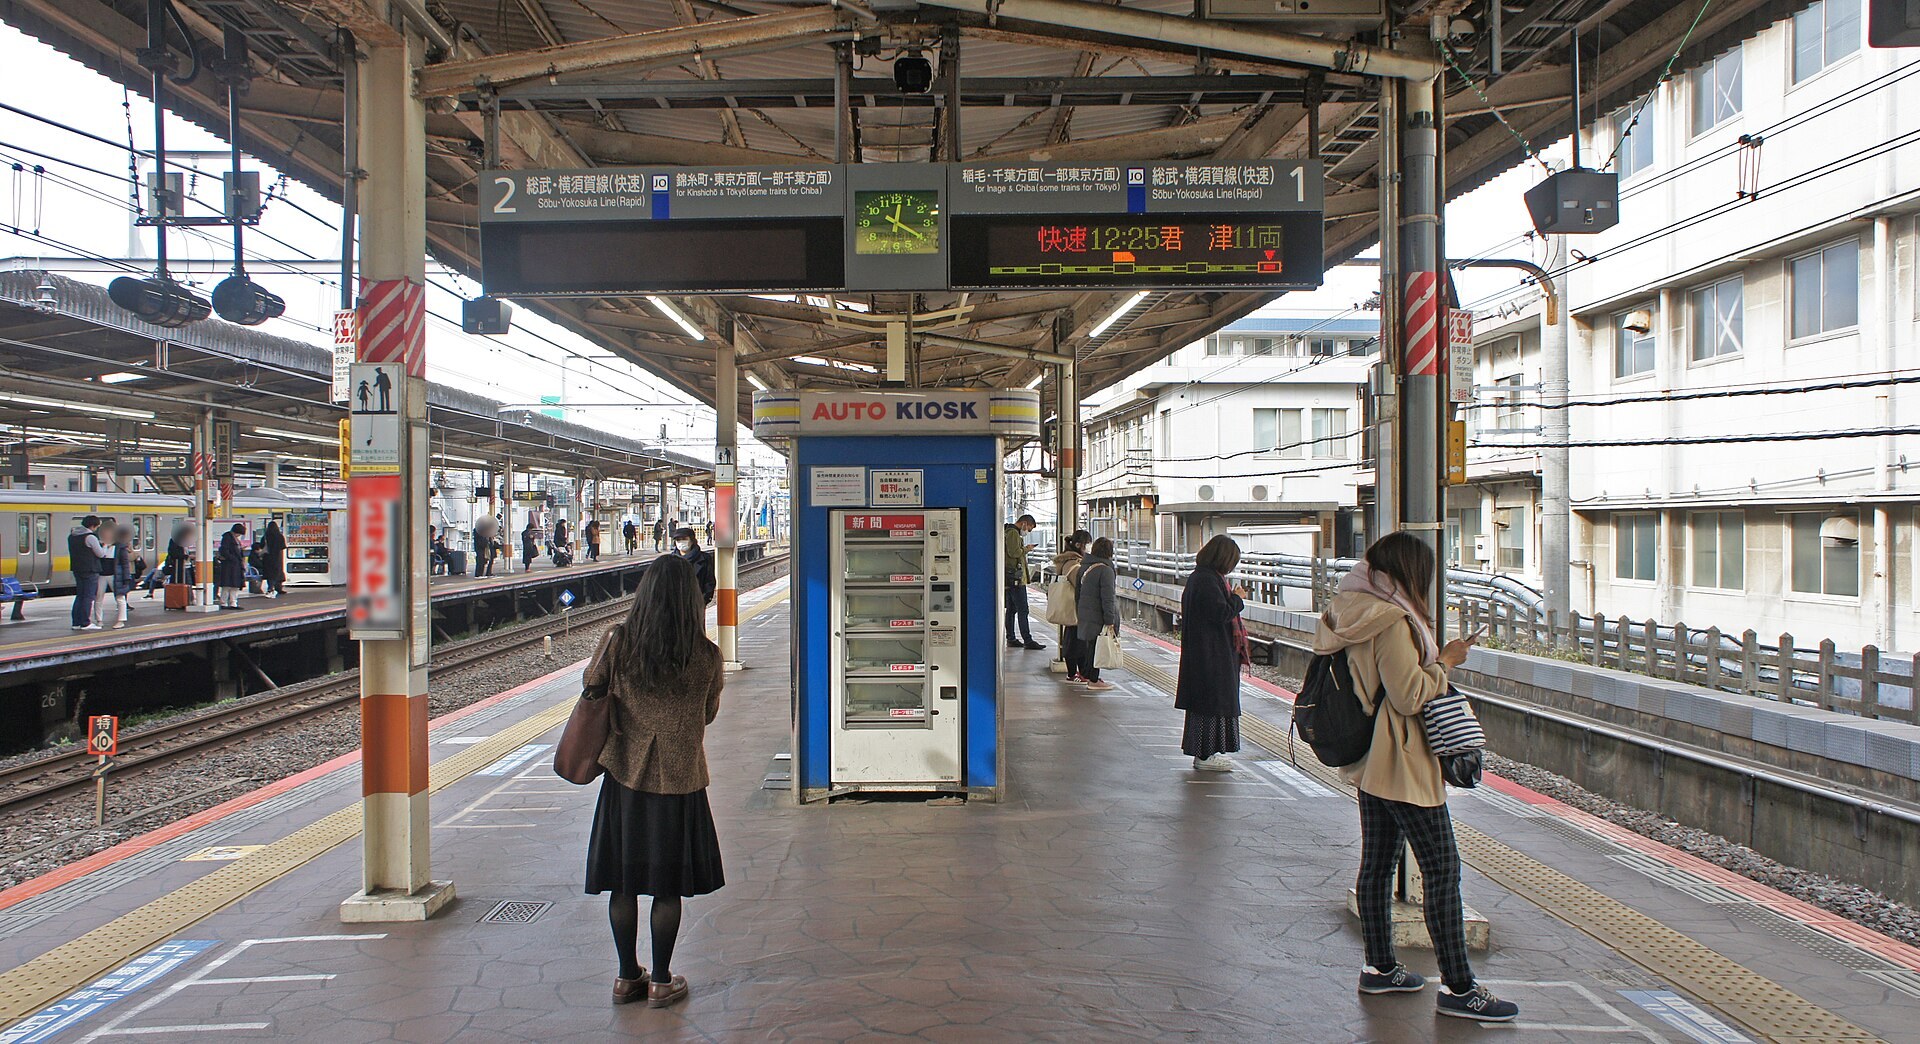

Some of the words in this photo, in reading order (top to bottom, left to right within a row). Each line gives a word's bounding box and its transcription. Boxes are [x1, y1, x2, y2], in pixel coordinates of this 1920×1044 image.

[676, 170, 832, 187] 錦糸町・東京方面(一部千葉方面)
[962, 167, 1121, 183] 稲毛・千葉方面(一部東京方面)
[1152, 165, 1275, 186] 総武・横須賀線(快速)
[526, 174, 646, 196] 総武・横須賀線(快速)
[975, 184, 985, 192] for
[987, 184, 1006, 194] Inage
[1009, 184, 1013, 192] &
[1061, 184, 1081, 192] trains
[1082, 184, 1092, 192] for
[1289, 166, 1304, 202] 1
[493, 177, 517, 214] 2
[720, 188, 724, 196] &
[769, 187, 788, 195] trains
[789, 187, 799, 195] for
[1216, 187, 1263, 201] Line(Rapid)
[600, 195, 646, 208] Line(Rapid)
[880, 200, 890, 208] 11
[891, 196, 902, 204] 12
[869, 207, 880, 215] 10
[917, 206, 925, 214] 2
[862, 219, 871, 227] 9
[923, 219, 931, 227] 3
[869, 233, 877, 241] 8
[1037, 225, 1087, 252] 快速
[1091, 226, 1160, 250] 12:25
[1233, 225, 1282, 249] 11両
[881, 240, 888, 248] 7
[893, 242, 900, 250] 6
[905, 240, 912, 248] 5
[812, 402, 886, 420] AUTO
[896, 401, 978, 420] KIOSK
[178, 456, 187, 469] 3
[852, 516, 882, 529] 新聞
[96, 717, 111, 730] 特
[96, 736, 109, 748] 10
[1467, 996, 1487, 1012] N
